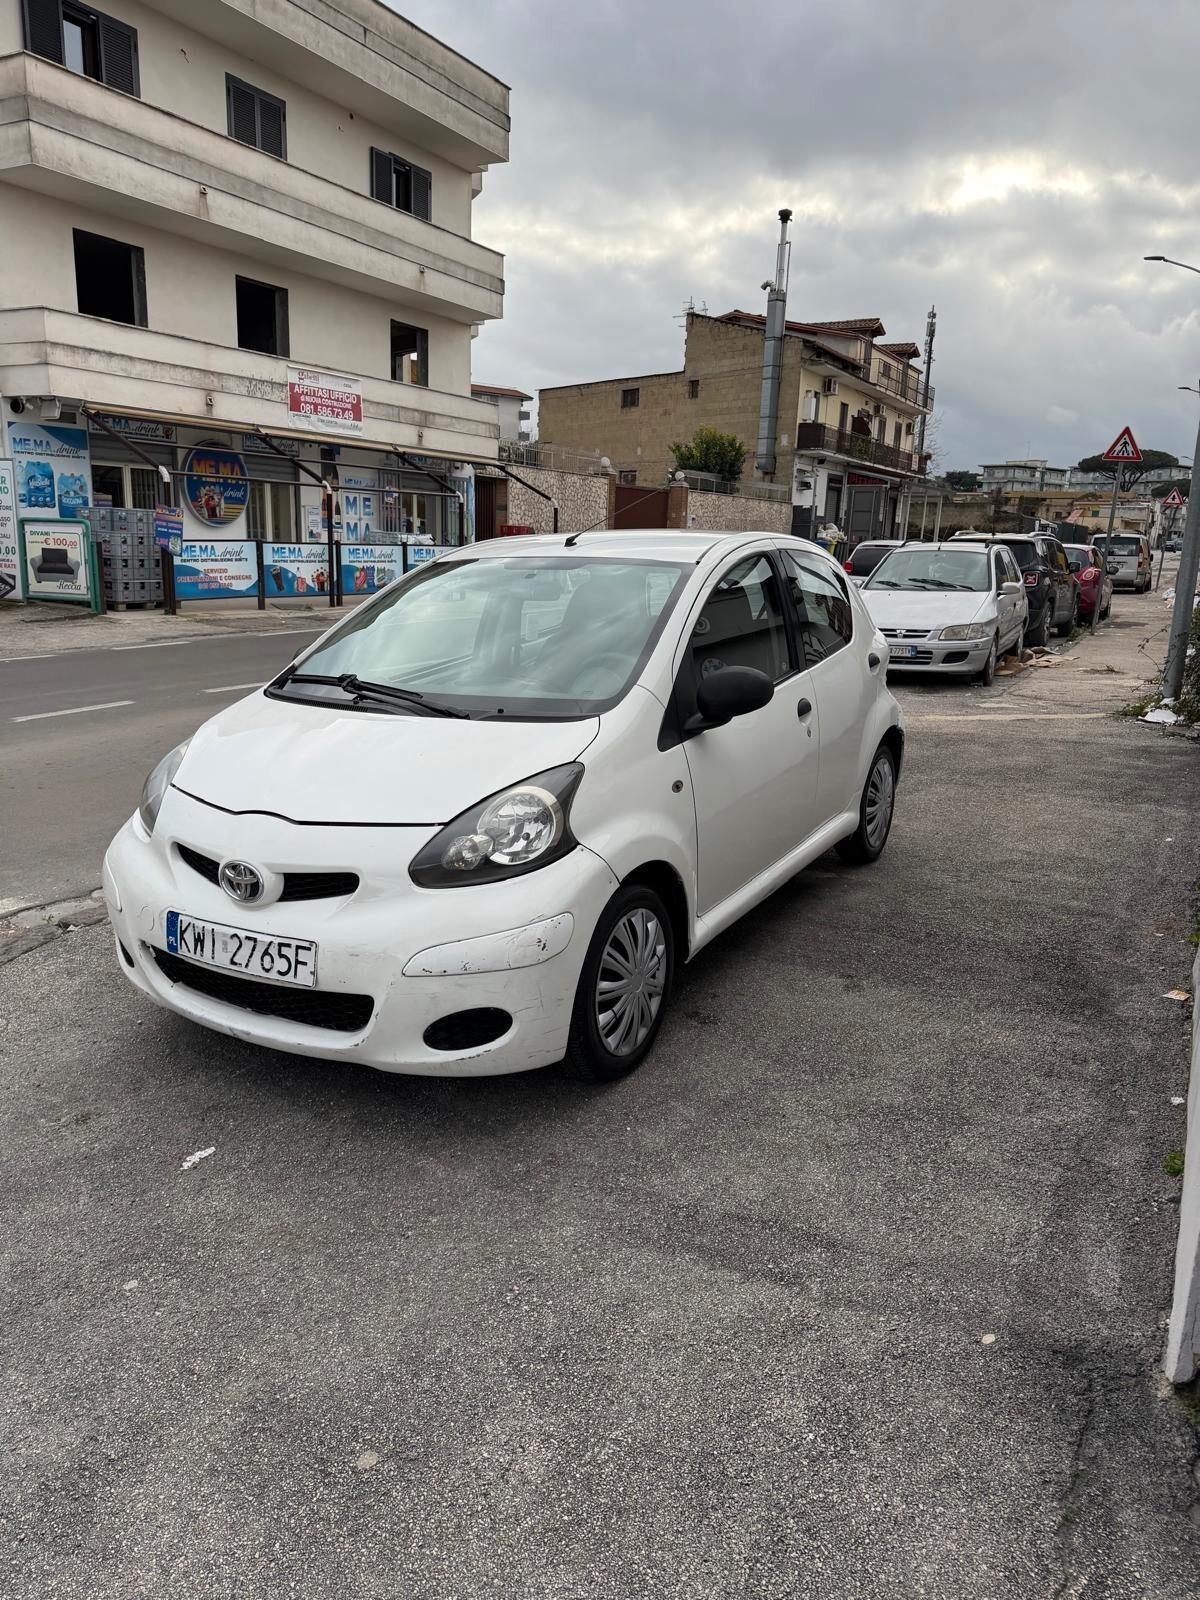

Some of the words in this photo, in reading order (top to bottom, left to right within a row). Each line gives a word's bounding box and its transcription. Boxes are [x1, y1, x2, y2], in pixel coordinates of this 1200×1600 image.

[294, 384, 330, 399] AFFITTASI
[330, 388, 356, 404] UFFICIO
[224, 488, 244, 502] drink
[220, 544, 244, 558] drink
[306, 546, 326, 560] drink
[168, 936, 178, 946] PL
[180, 918, 216, 960] KWI
[230, 932, 312, 979] 2765F
